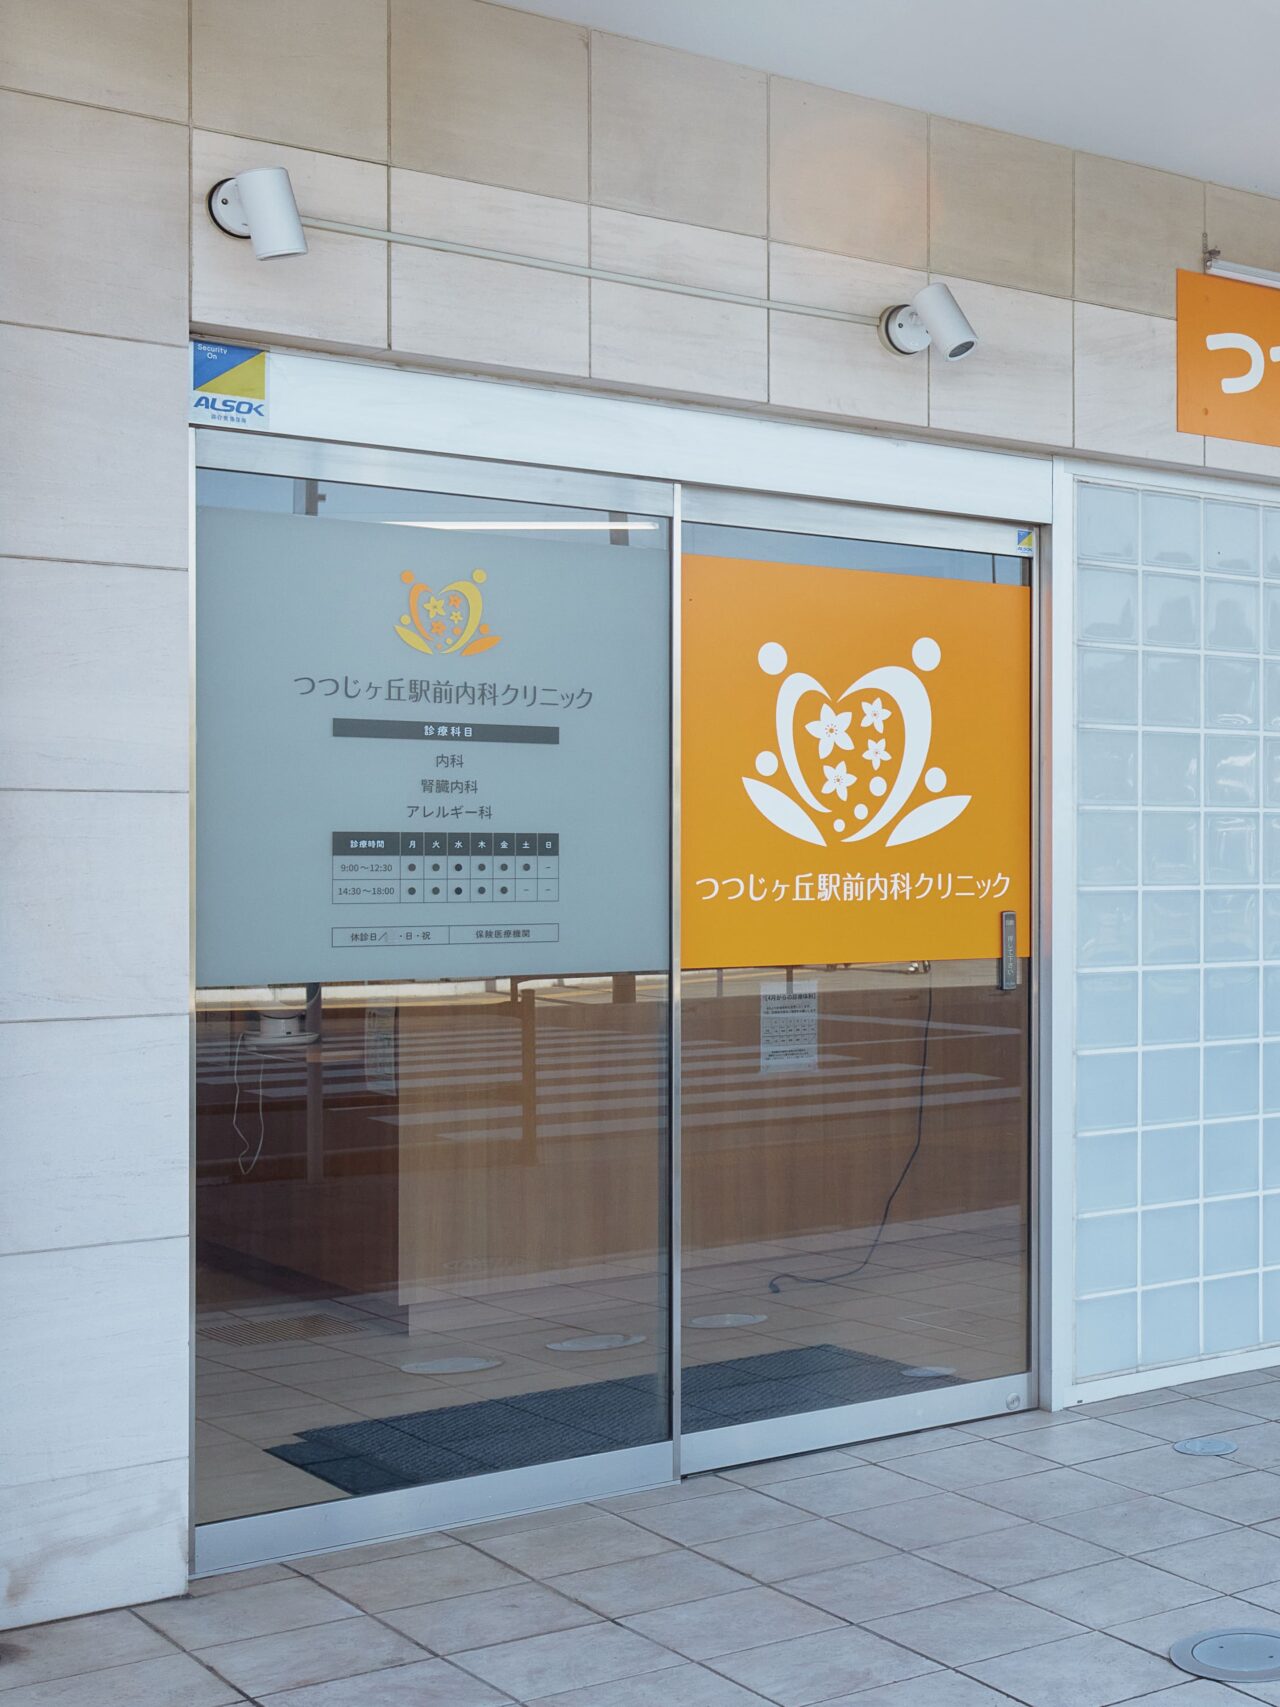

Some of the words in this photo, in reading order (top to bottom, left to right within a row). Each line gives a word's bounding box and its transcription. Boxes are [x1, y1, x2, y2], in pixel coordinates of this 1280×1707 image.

[197, 344, 228, 354] Security
[207, 352, 218, 360] On
[193, 395, 265, 417] ALSOK
[294, 675, 593, 709] つつじヶ丘駅前内科クリニック
[424, 725, 473, 737] 診療科目
[435, 753, 464, 768] 内科
[420, 779, 479, 794] 腎臓内科
[407, 805, 493, 819] アレルギー科
[349, 839, 385, 849] 診療時間
[408, 840, 416, 849] 月
[431, 840, 441, 849] 火
[454, 840, 463, 849] 水
[477, 840, 487, 849] 木
[500, 840, 509, 849] 金
[522, 840, 531, 849] 土
[545, 840, 552, 849] 日
[695, 872, 1011, 902] つつじヶ丘駅前内科クリニック
[475, 929, 531, 939] 保険医療機関
